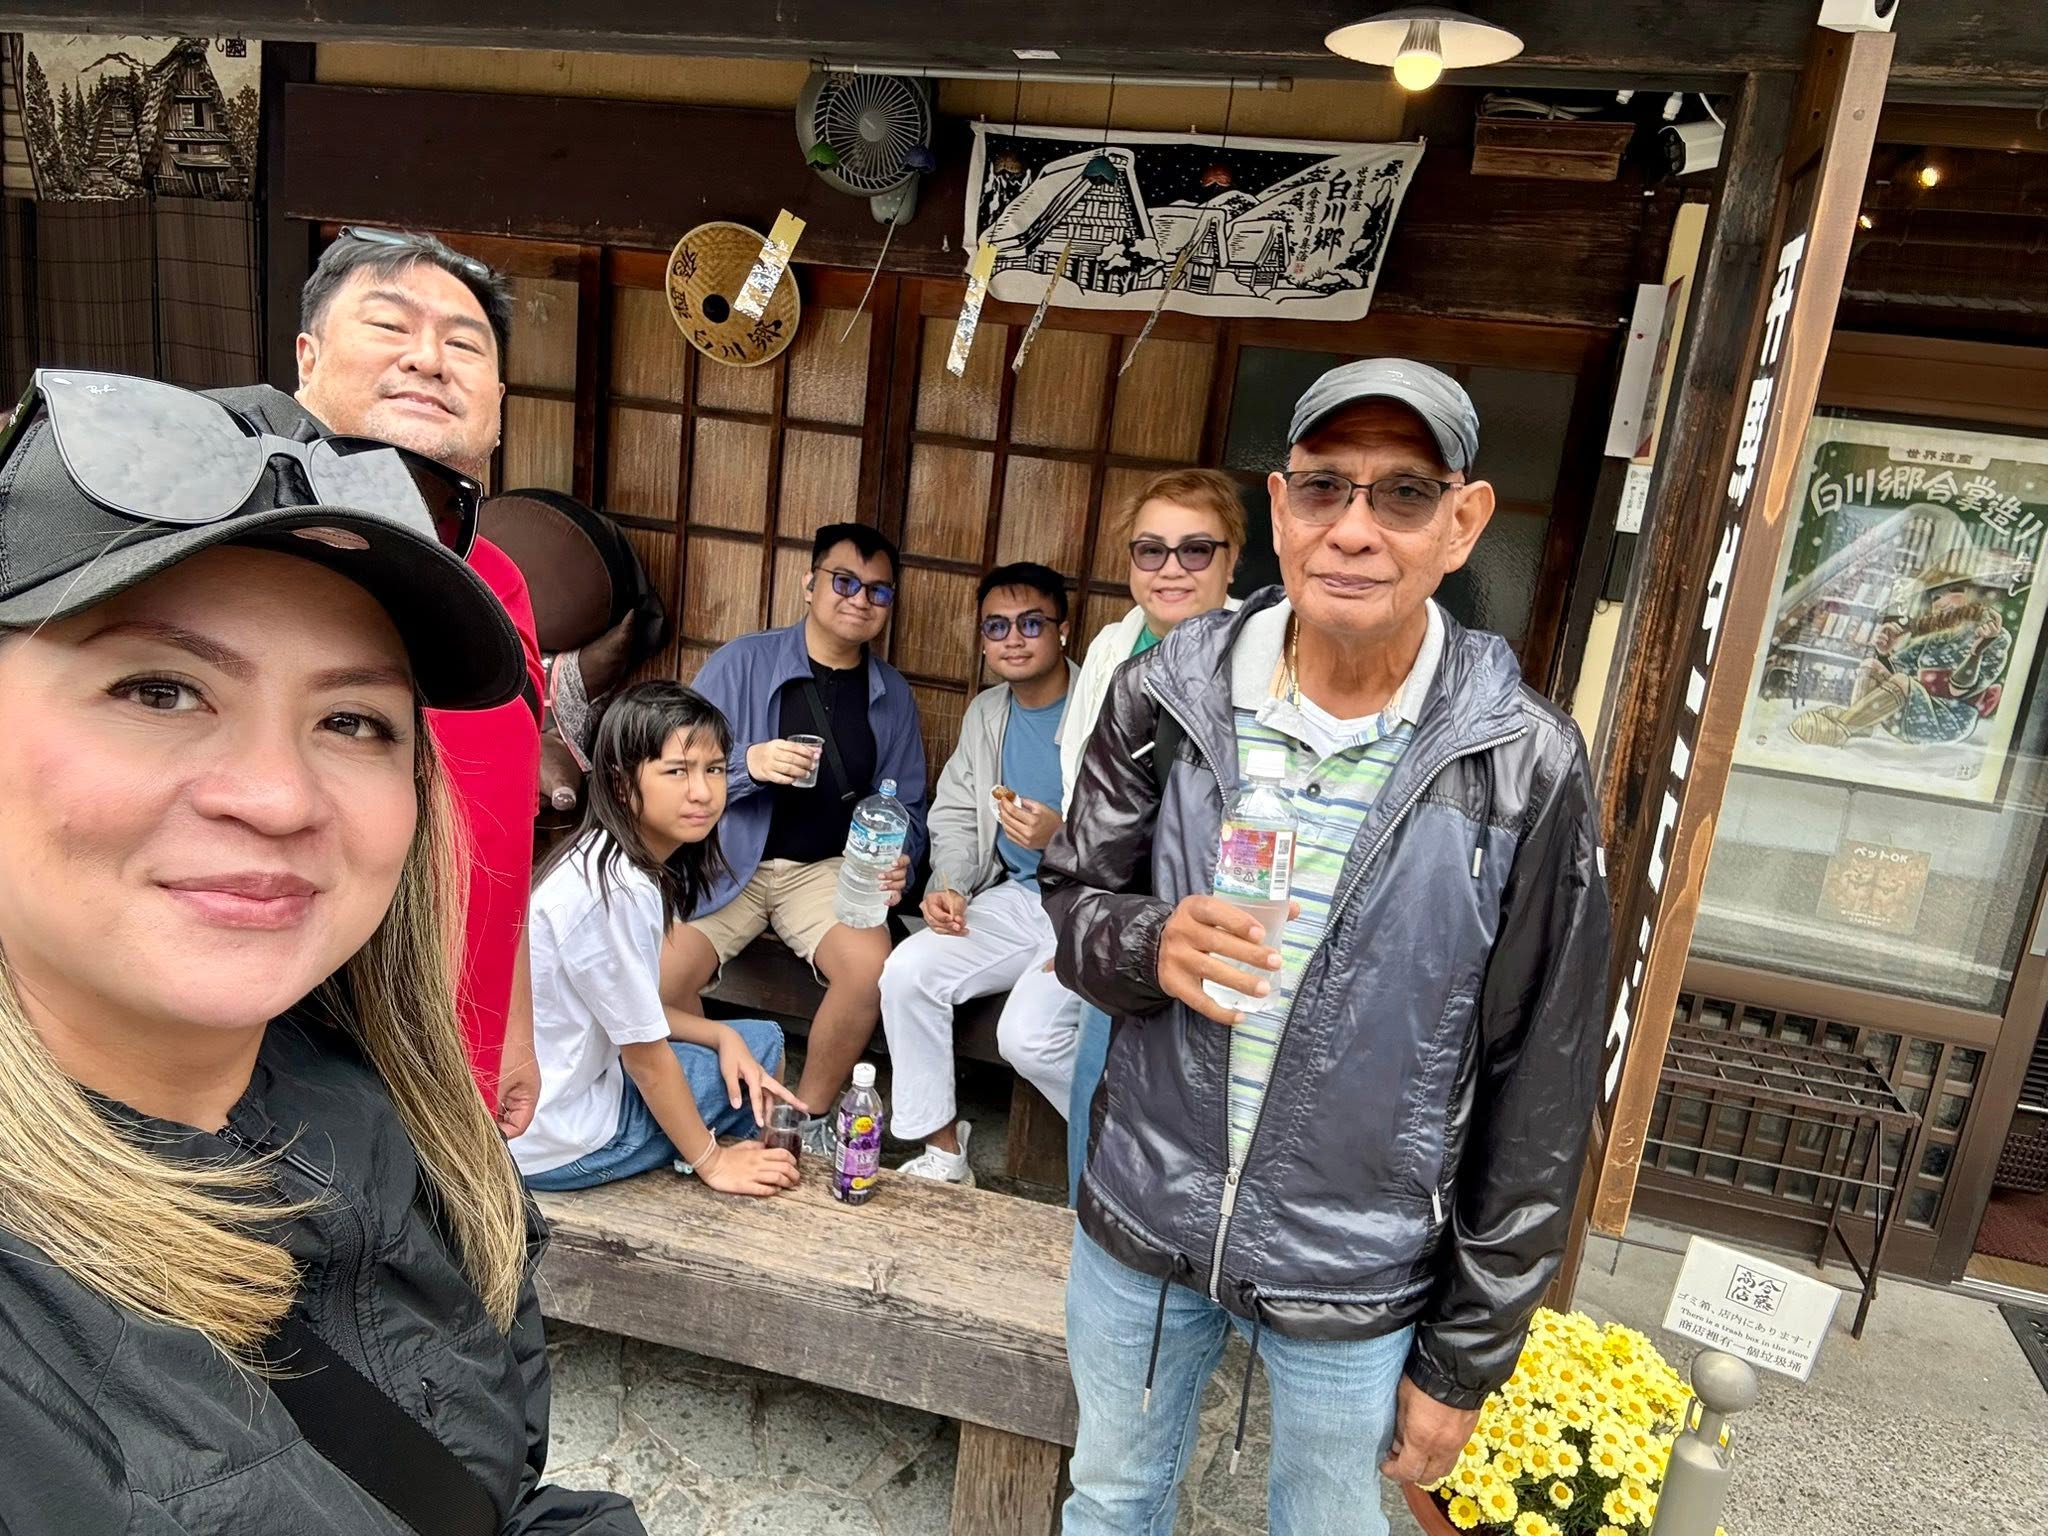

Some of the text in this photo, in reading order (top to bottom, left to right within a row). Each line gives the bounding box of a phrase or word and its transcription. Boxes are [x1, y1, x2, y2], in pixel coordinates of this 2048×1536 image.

[1309, 169, 1352, 262] 白川郷
[1906, 448, 1973, 465] 世界遺産
[1811, 466, 2043, 542] 白川郷合掌造り
[1681, 1306, 1704, 1321] There
[1705, 1316, 1713, 1325] is
[1722, 1325, 1743, 1338] trash
[1745, 1333, 1759, 1343] box
[1761, 1339, 1770, 1348] in
[1772, 1343, 1786, 1353] the
[1787, 1349, 1808, 1361] store
